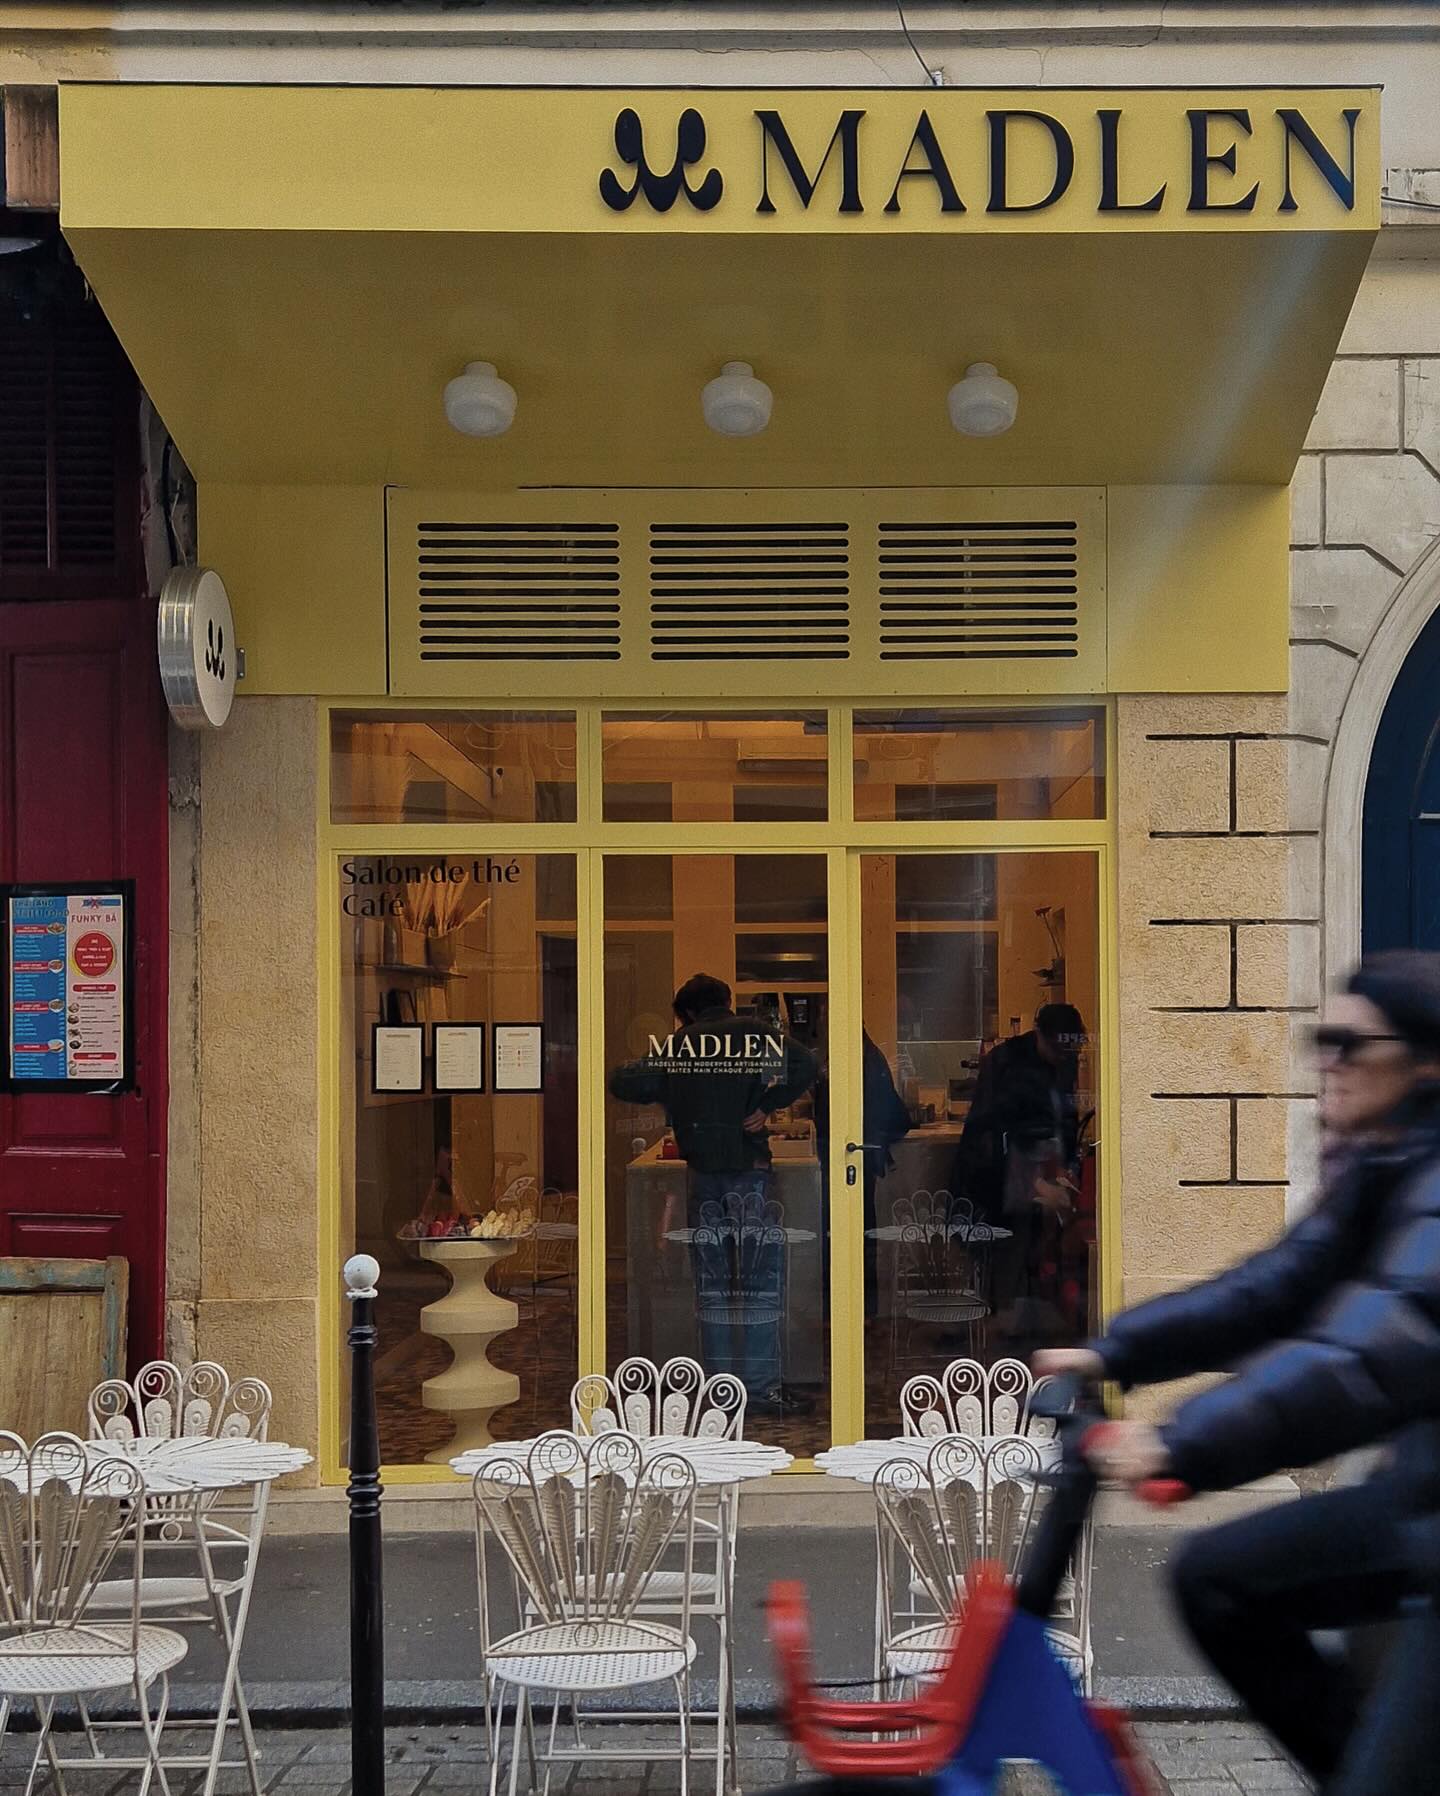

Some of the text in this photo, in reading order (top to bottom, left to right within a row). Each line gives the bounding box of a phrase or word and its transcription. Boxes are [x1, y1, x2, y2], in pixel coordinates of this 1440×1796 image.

[755, 108, 1362, 213] MADLEN
[342, 858, 520, 885] Salon de thé
[342, 892, 404, 917] Café
[71, 915, 101, 923] FUNKY
[648, 1034, 784, 1058] MADLEN
